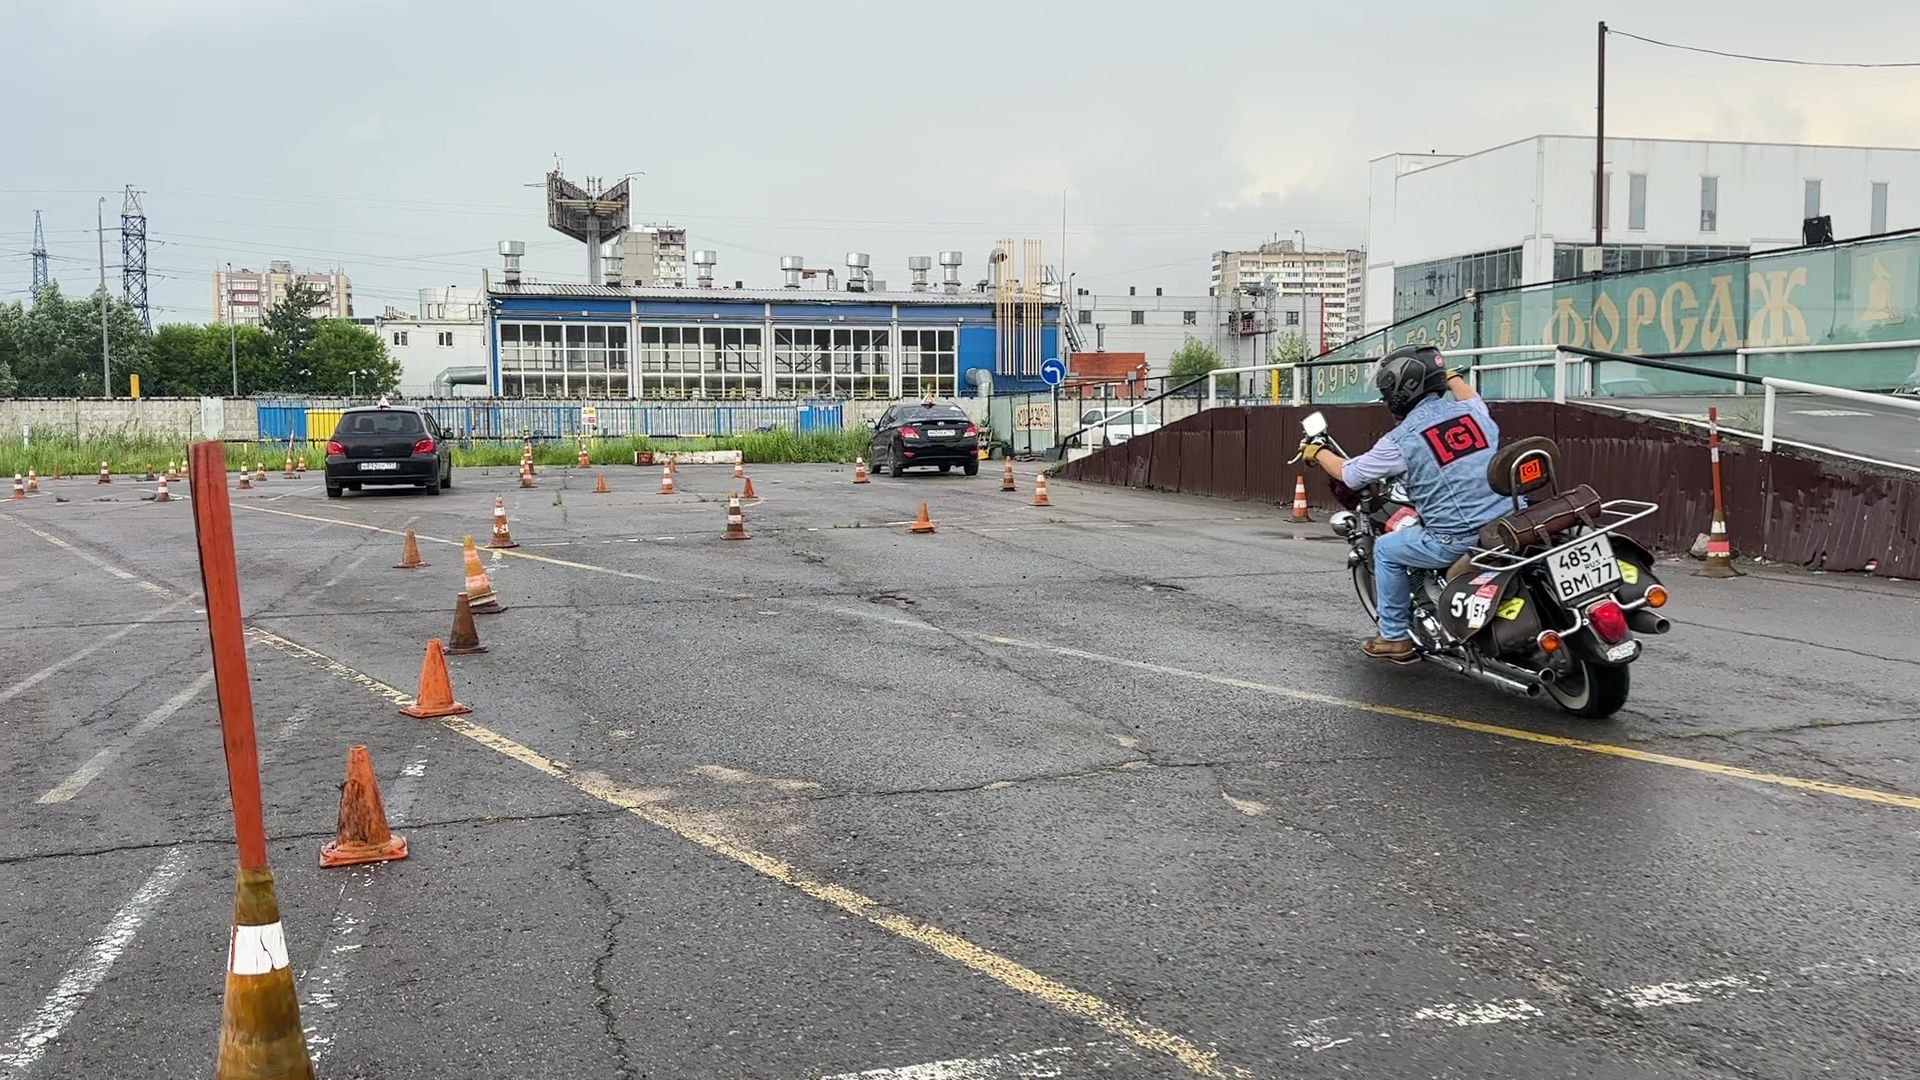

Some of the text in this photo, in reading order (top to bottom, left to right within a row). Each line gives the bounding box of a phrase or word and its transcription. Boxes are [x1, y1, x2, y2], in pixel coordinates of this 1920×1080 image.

[1543, 267, 1811, 355] ФОРСАЖ
[1317, 367, 1326, 397] 8
[1559, 541, 1602, 571] 4851
[1585, 560, 1602, 570] RUS
[1591, 562, 1613, 584] 77
